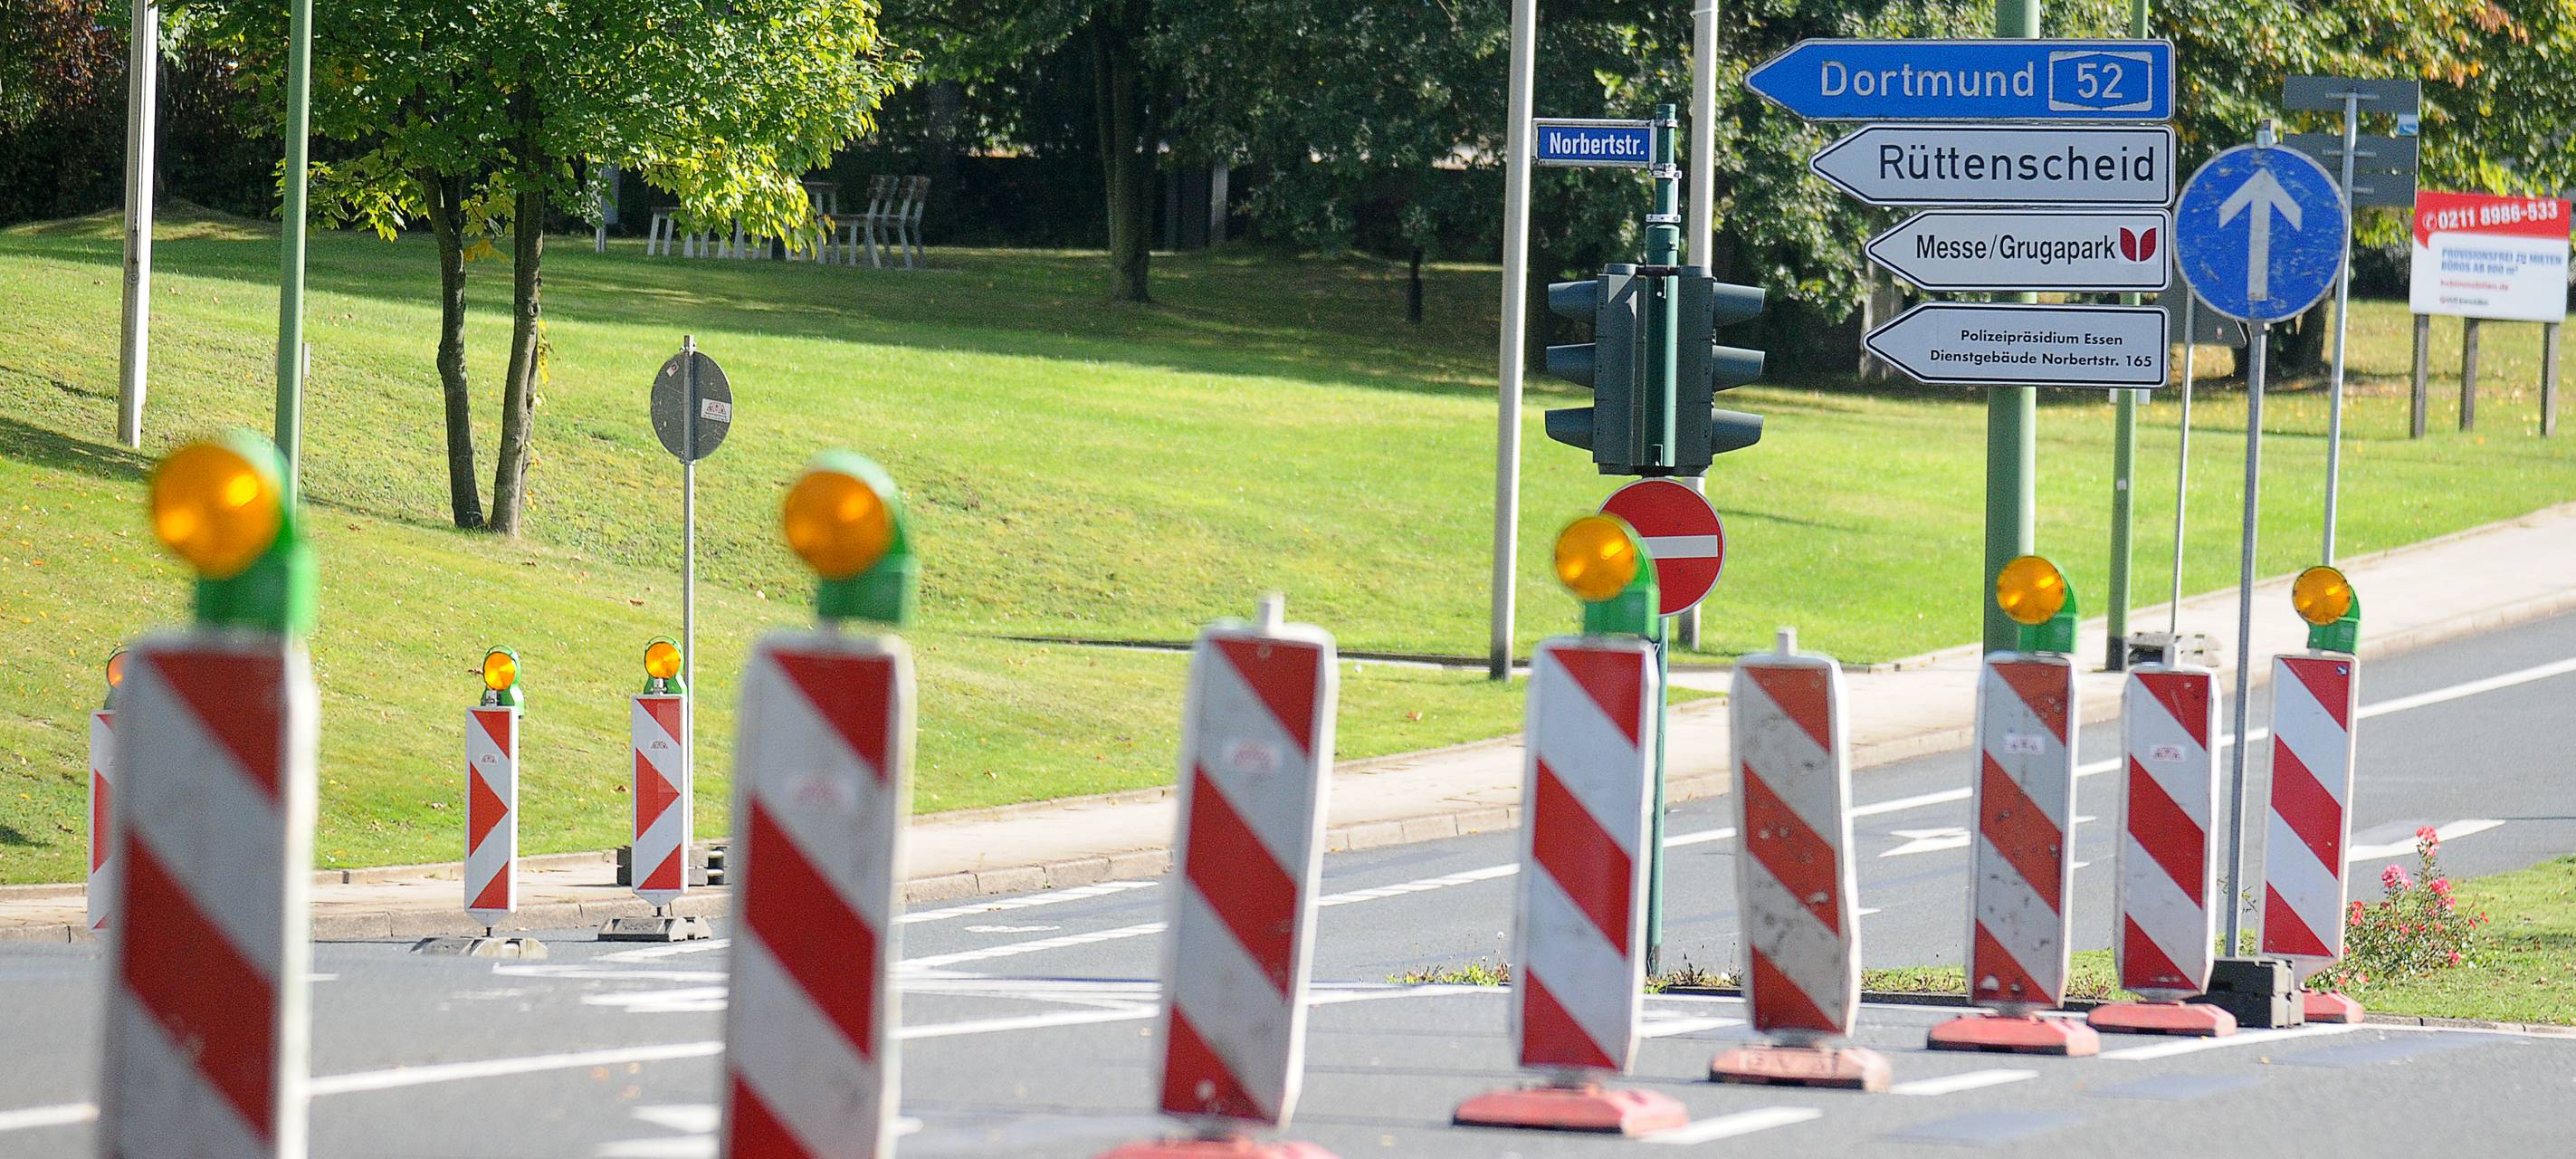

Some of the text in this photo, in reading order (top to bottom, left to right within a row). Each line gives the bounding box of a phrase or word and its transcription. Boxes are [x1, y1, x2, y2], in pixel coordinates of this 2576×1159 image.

[1820, 60, 2123, 99] Dortmund 52
[1550, 132, 1645, 156] Norbertstr.
[1879, 144, 2155, 181] Rüttenscheid
[2438, 206, 2476, 230] 0211
[1961, 330, 2123, 347] Polizeipräsidium Essen
[1931, 350, 2152, 368] Dienstgebäude Norbertstr. 165
